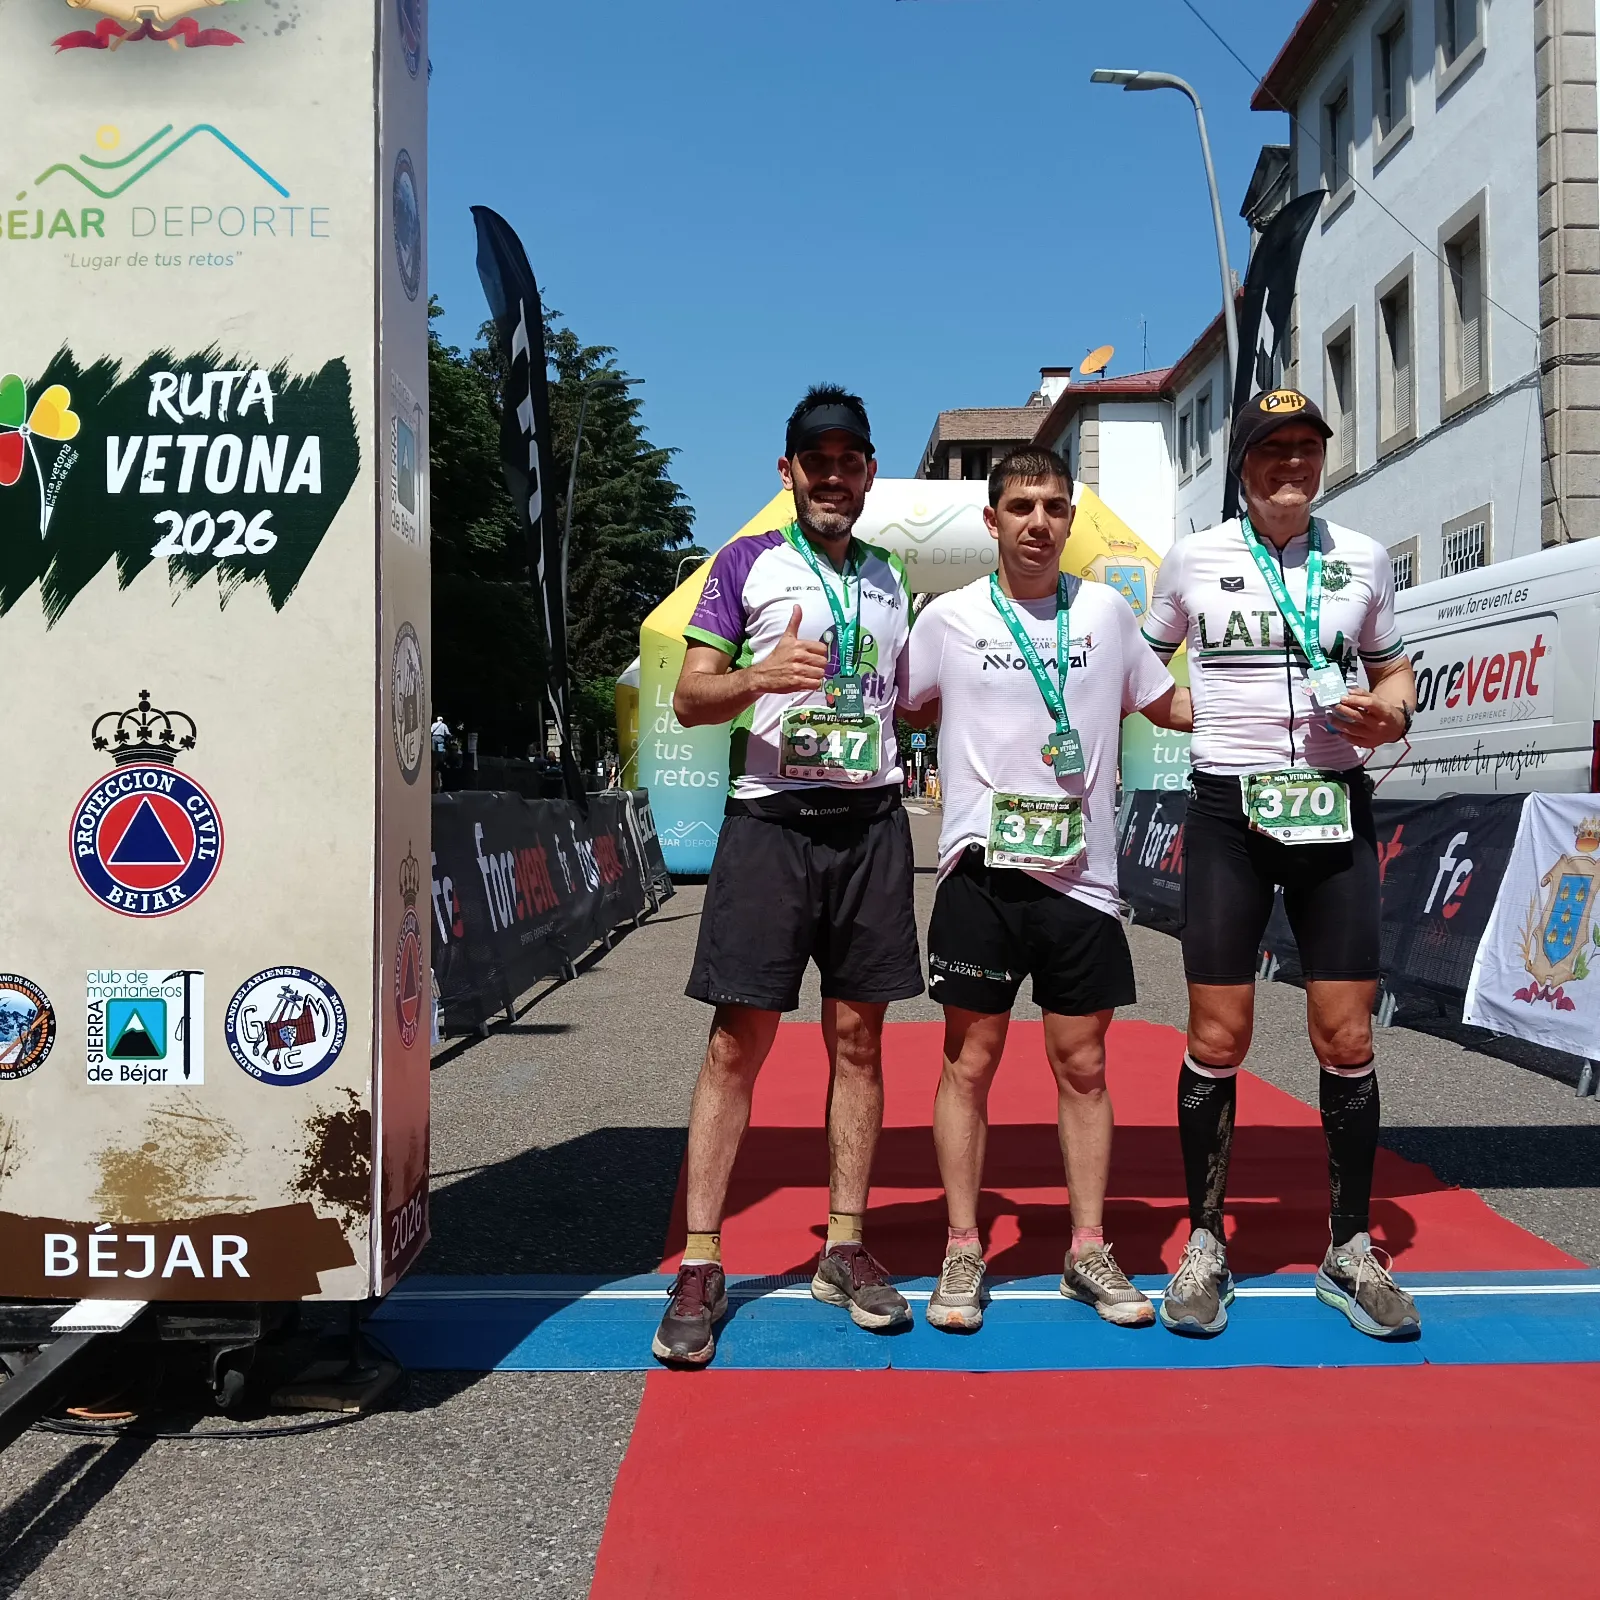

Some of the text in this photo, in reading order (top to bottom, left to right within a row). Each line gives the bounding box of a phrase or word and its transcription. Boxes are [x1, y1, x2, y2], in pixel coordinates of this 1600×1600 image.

[0, 191, 330, 239] ÉJAR DEPORTE
[127, 252, 148, 266] de
[154, 253, 181, 266] tus
[147, 369, 277, 424] RUTA
[64, 450, 79, 468] Béjar
[106, 434, 322, 494] VETONA
[45, 443, 72, 506] ruta vetona
[60, 468, 69, 480] de
[150, 509, 278, 558] 2026
[933, 548, 995, 565] DEPO
[1437, 587, 1529, 621] www.forevent.es
[1025, 644, 1041, 667] VETONA
[655, 711, 684, 735] de
[1048, 690, 1069, 727] RUTA VETONA
[1440, 709, 1507, 725] SPORTS EXPERIENCE
[654, 739, 694, 761] tus
[794, 727, 868, 761] 347
[1059, 743, 1079, 752] VETONA
[654, 766, 720, 788] retos
[1435, 753, 1471, 777] mueve
[1472, 739, 1492, 776] tu
[1495, 741, 1549, 790] pasión
[1153, 770, 1192, 790] ret
[76, 772, 216, 861] PROTECCION CIVIL
[800, 807, 850, 816] SALOMON
[1035, 802, 1059, 810] VETONA
[1258, 787, 1335, 819] 370
[658, 834, 681, 847] ÉJAR
[1002, 815, 1070, 847] 371
[106, 884, 187, 911] BEJAR
[86, 970, 149, 984] club de
[86, 983, 182, 998] montañeros
[14, 976, 24, 984] DE
[24, 981, 51, 1010] MONTAÑA
[87, 999, 104, 1064] SIERRA
[227, 968, 345, 1078] GRUPO CANDELARIENSE DE MONTAÑA
[18, 1063, 38, 1077] 1968
[39, 1035, 54, 1060] 2018
[87, 1064, 169, 1085] de Béjar
[391, 1190, 422, 1260] 2026
[44, 1222, 251, 1279] BÉJAR
